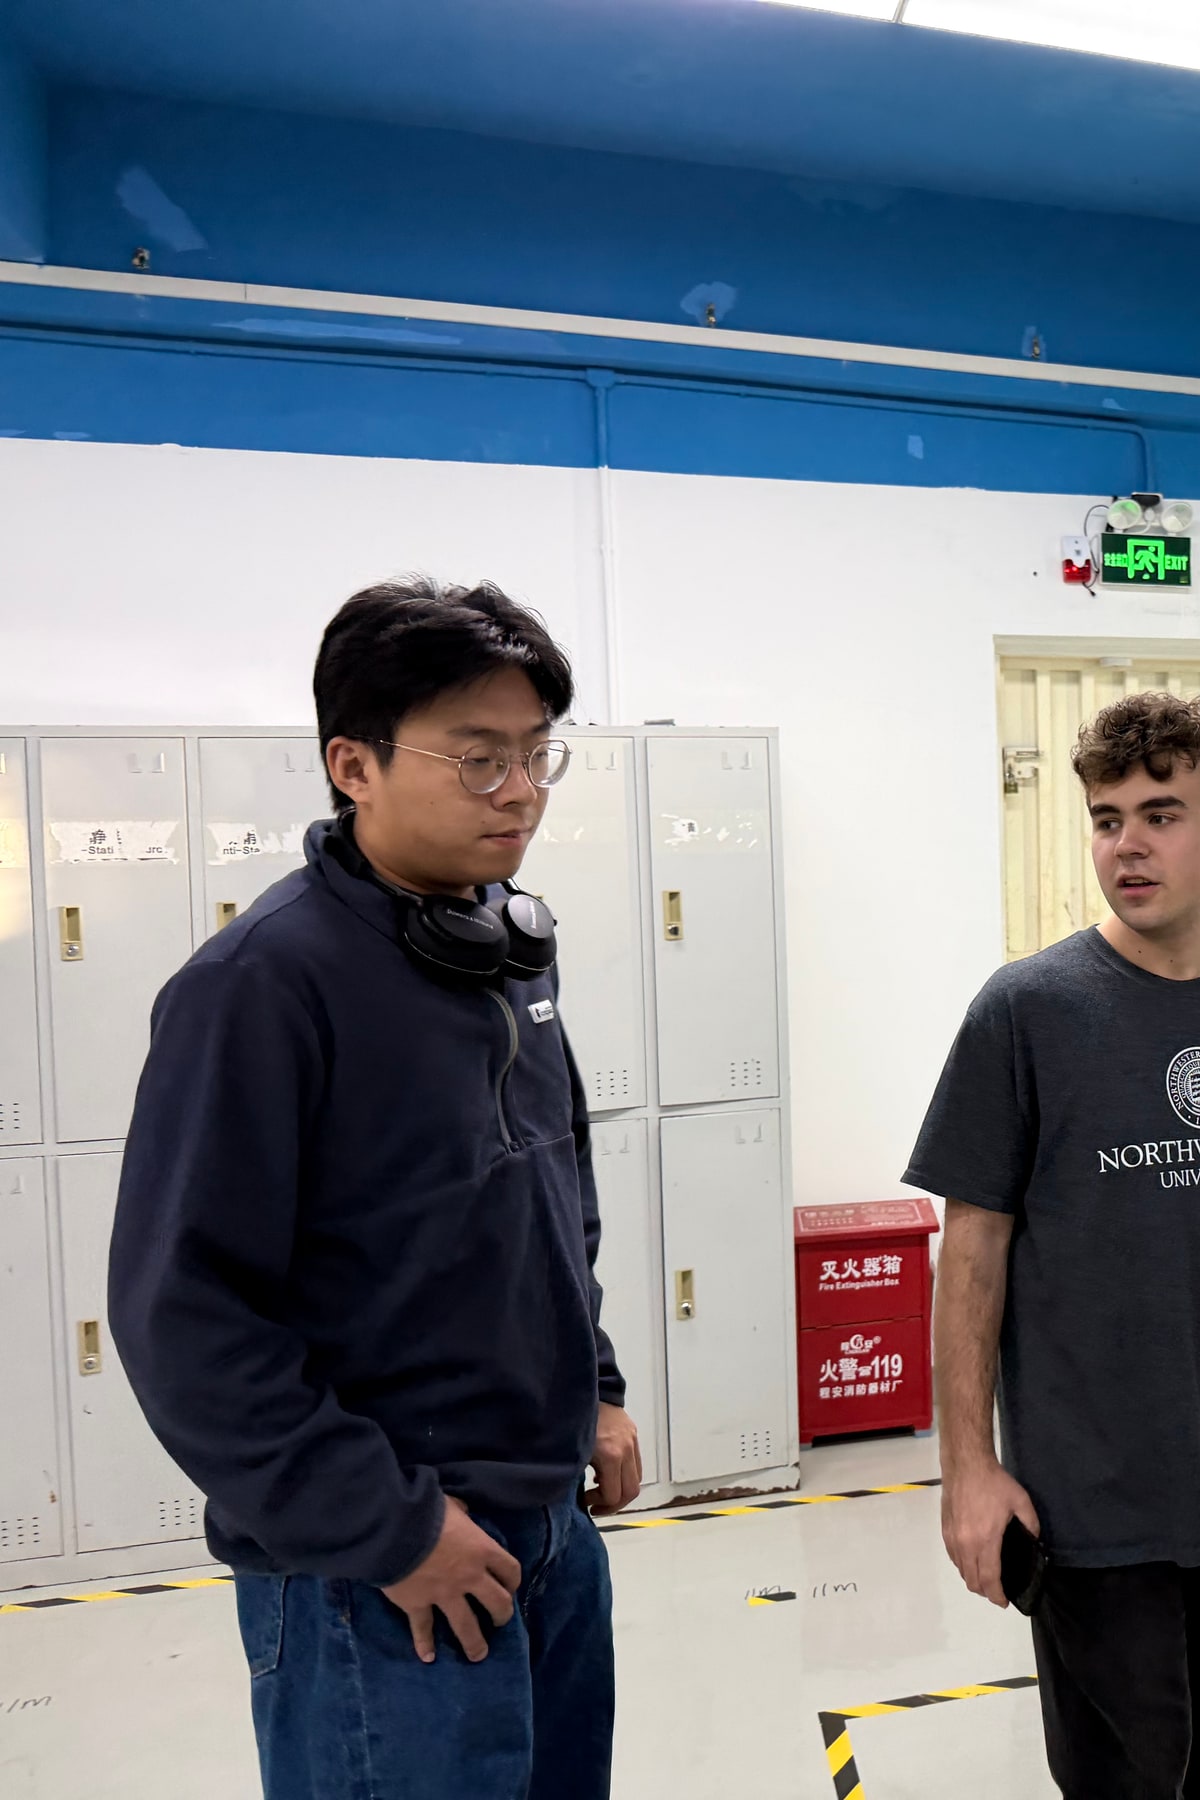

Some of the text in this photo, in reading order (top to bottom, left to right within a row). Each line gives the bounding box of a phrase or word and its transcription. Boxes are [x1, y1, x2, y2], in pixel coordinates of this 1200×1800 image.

[1165, 554, 1189, 571] EXIT
[820, 1255, 903, 1280] 灭火器箱
[819, 1278, 900, 1292] Fire Extinguisher Box
[819, 1353, 903, 1383] 火警 119
